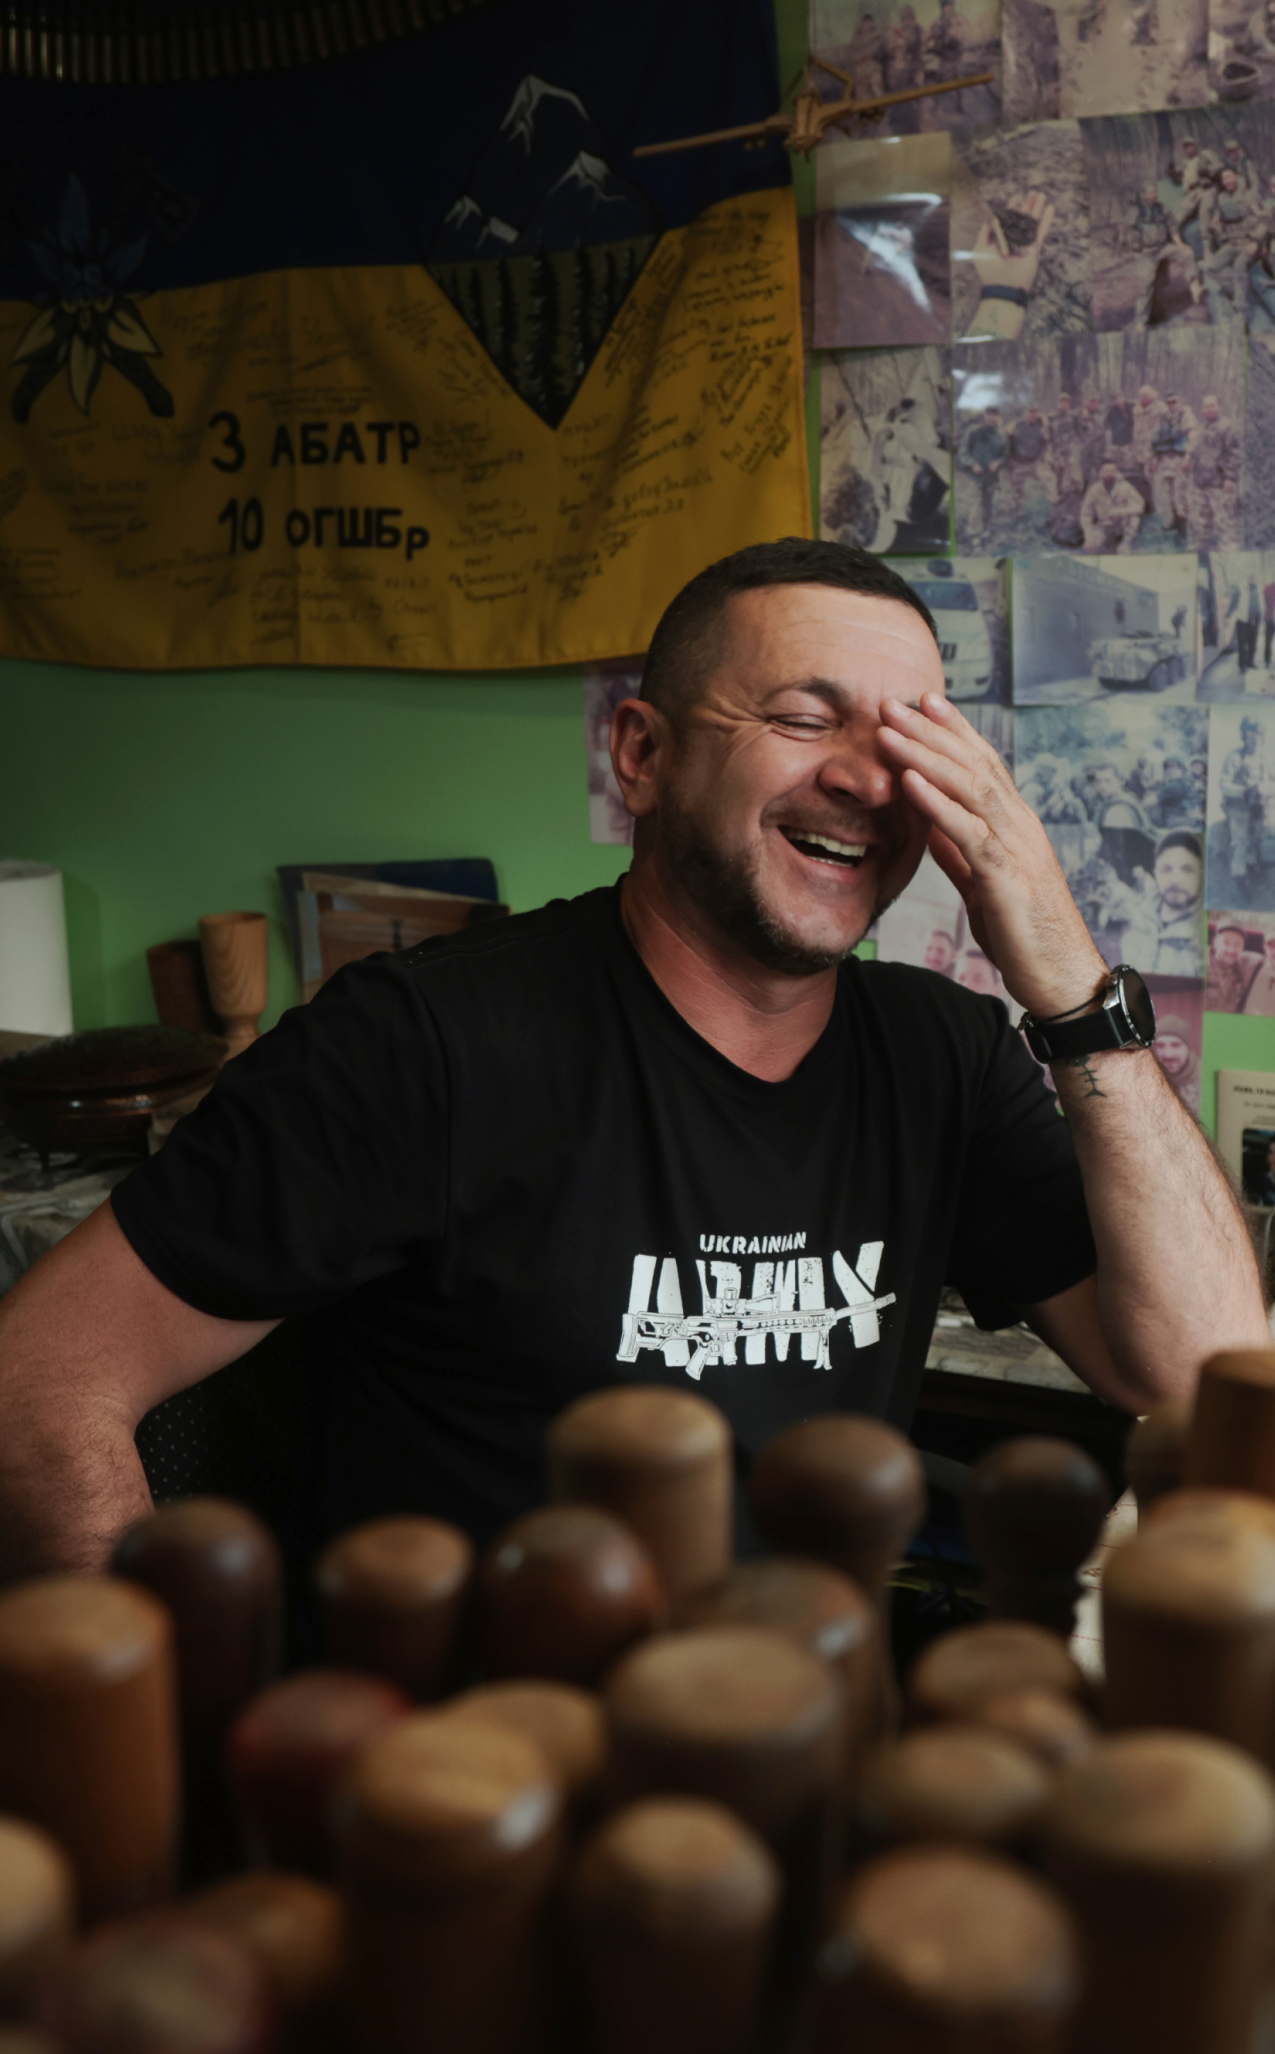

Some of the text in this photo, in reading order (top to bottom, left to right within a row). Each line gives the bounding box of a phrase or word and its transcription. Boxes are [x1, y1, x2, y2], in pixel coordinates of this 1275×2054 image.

[208, 409, 247, 474] 3
[269, 420, 423, 468] АБАТР
[217, 496, 265, 555] 10
[699, 1231, 807, 1255] UKRAINIAN
[616, 1240, 886, 1368] ARMY
